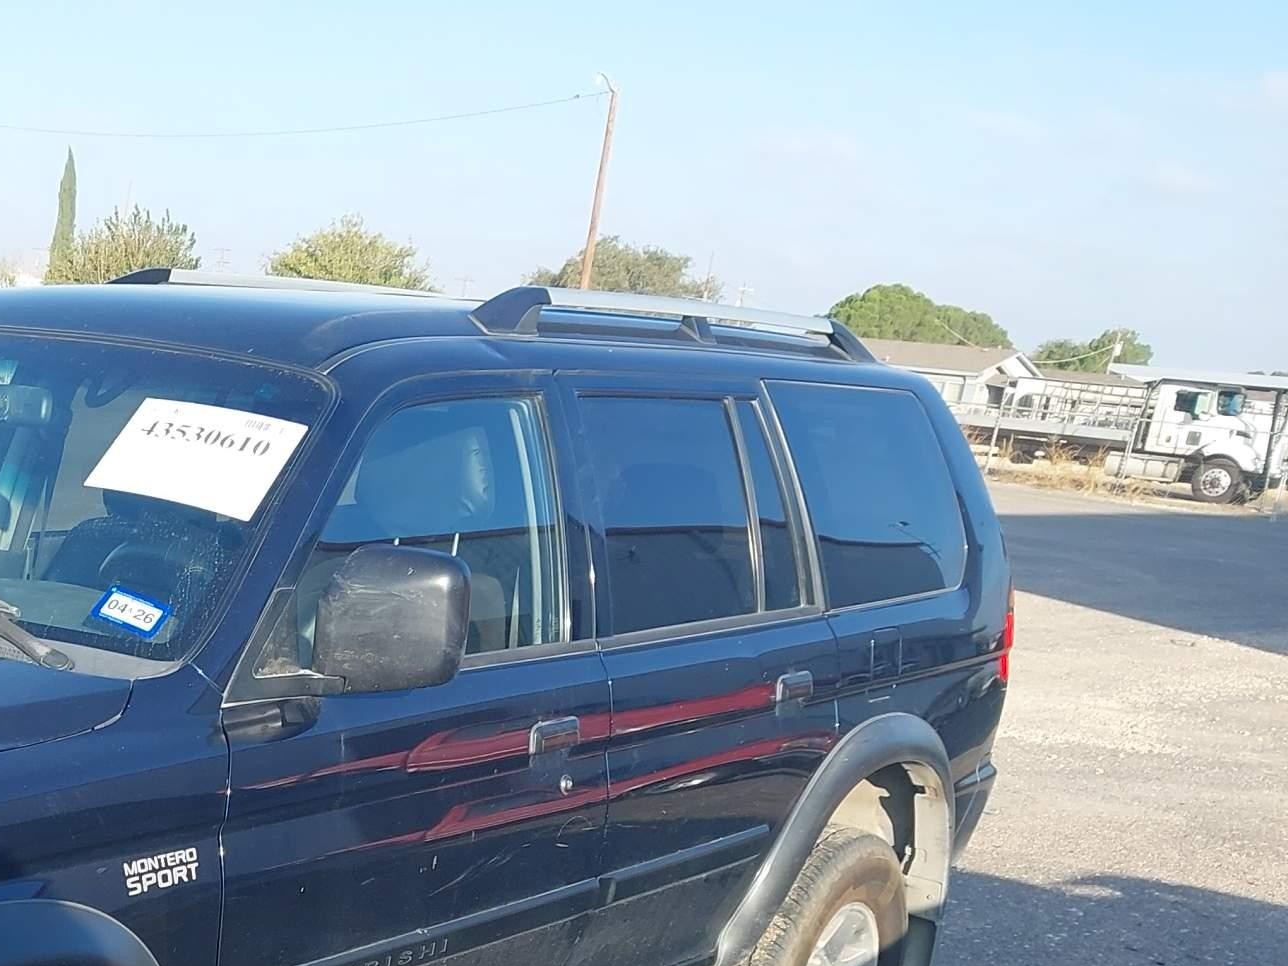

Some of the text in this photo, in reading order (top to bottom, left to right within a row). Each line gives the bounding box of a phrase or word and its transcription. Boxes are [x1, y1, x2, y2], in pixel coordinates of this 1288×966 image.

[140, 420, 271, 456] 43530610
[107, 599, 128, 613] 04
[133, 608, 156, 624] 26
[123, 847, 197, 876] MONTERO
[126, 862, 199, 896] SPORT
